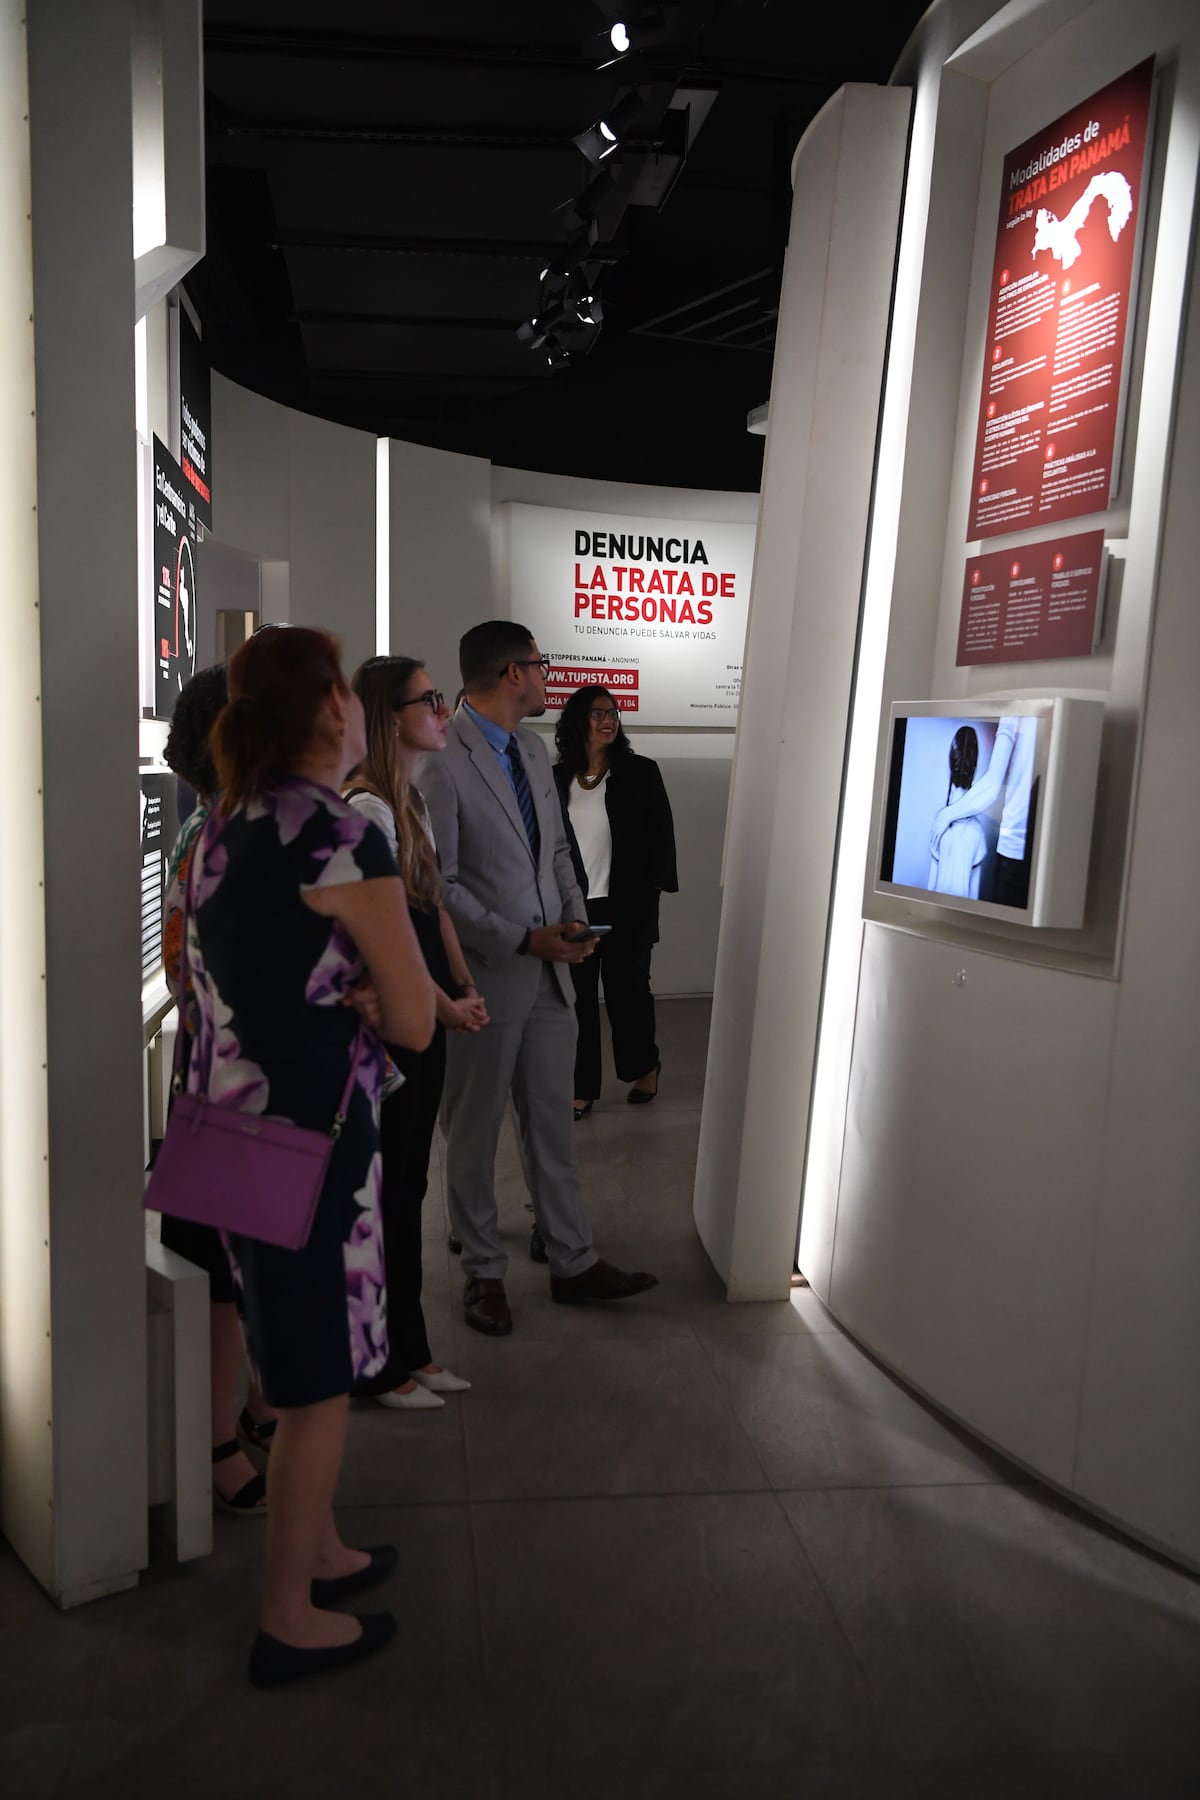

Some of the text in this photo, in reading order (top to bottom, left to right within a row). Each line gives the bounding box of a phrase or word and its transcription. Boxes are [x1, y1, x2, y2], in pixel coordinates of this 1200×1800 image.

[1008, 113, 1131, 216] TRATA EN PANAMÁ
[1009, 120, 1100, 190] Modalidades de
[575, 530, 709, 565] DENUNCIA
[575, 563, 736, 598] LA TRATA DE
[574, 592, 713, 625] PERSONAS
[575, 625, 716, 640] TU DENUNCIA PUEDE SALVAR VIDAS
[551, 653, 580, 661] STOPPERS
[547, 671, 634, 684] WW.TUPISTA.ORG
[545, 695, 563, 705] LICÍA
[617, 699, 635, 708] Y 104
